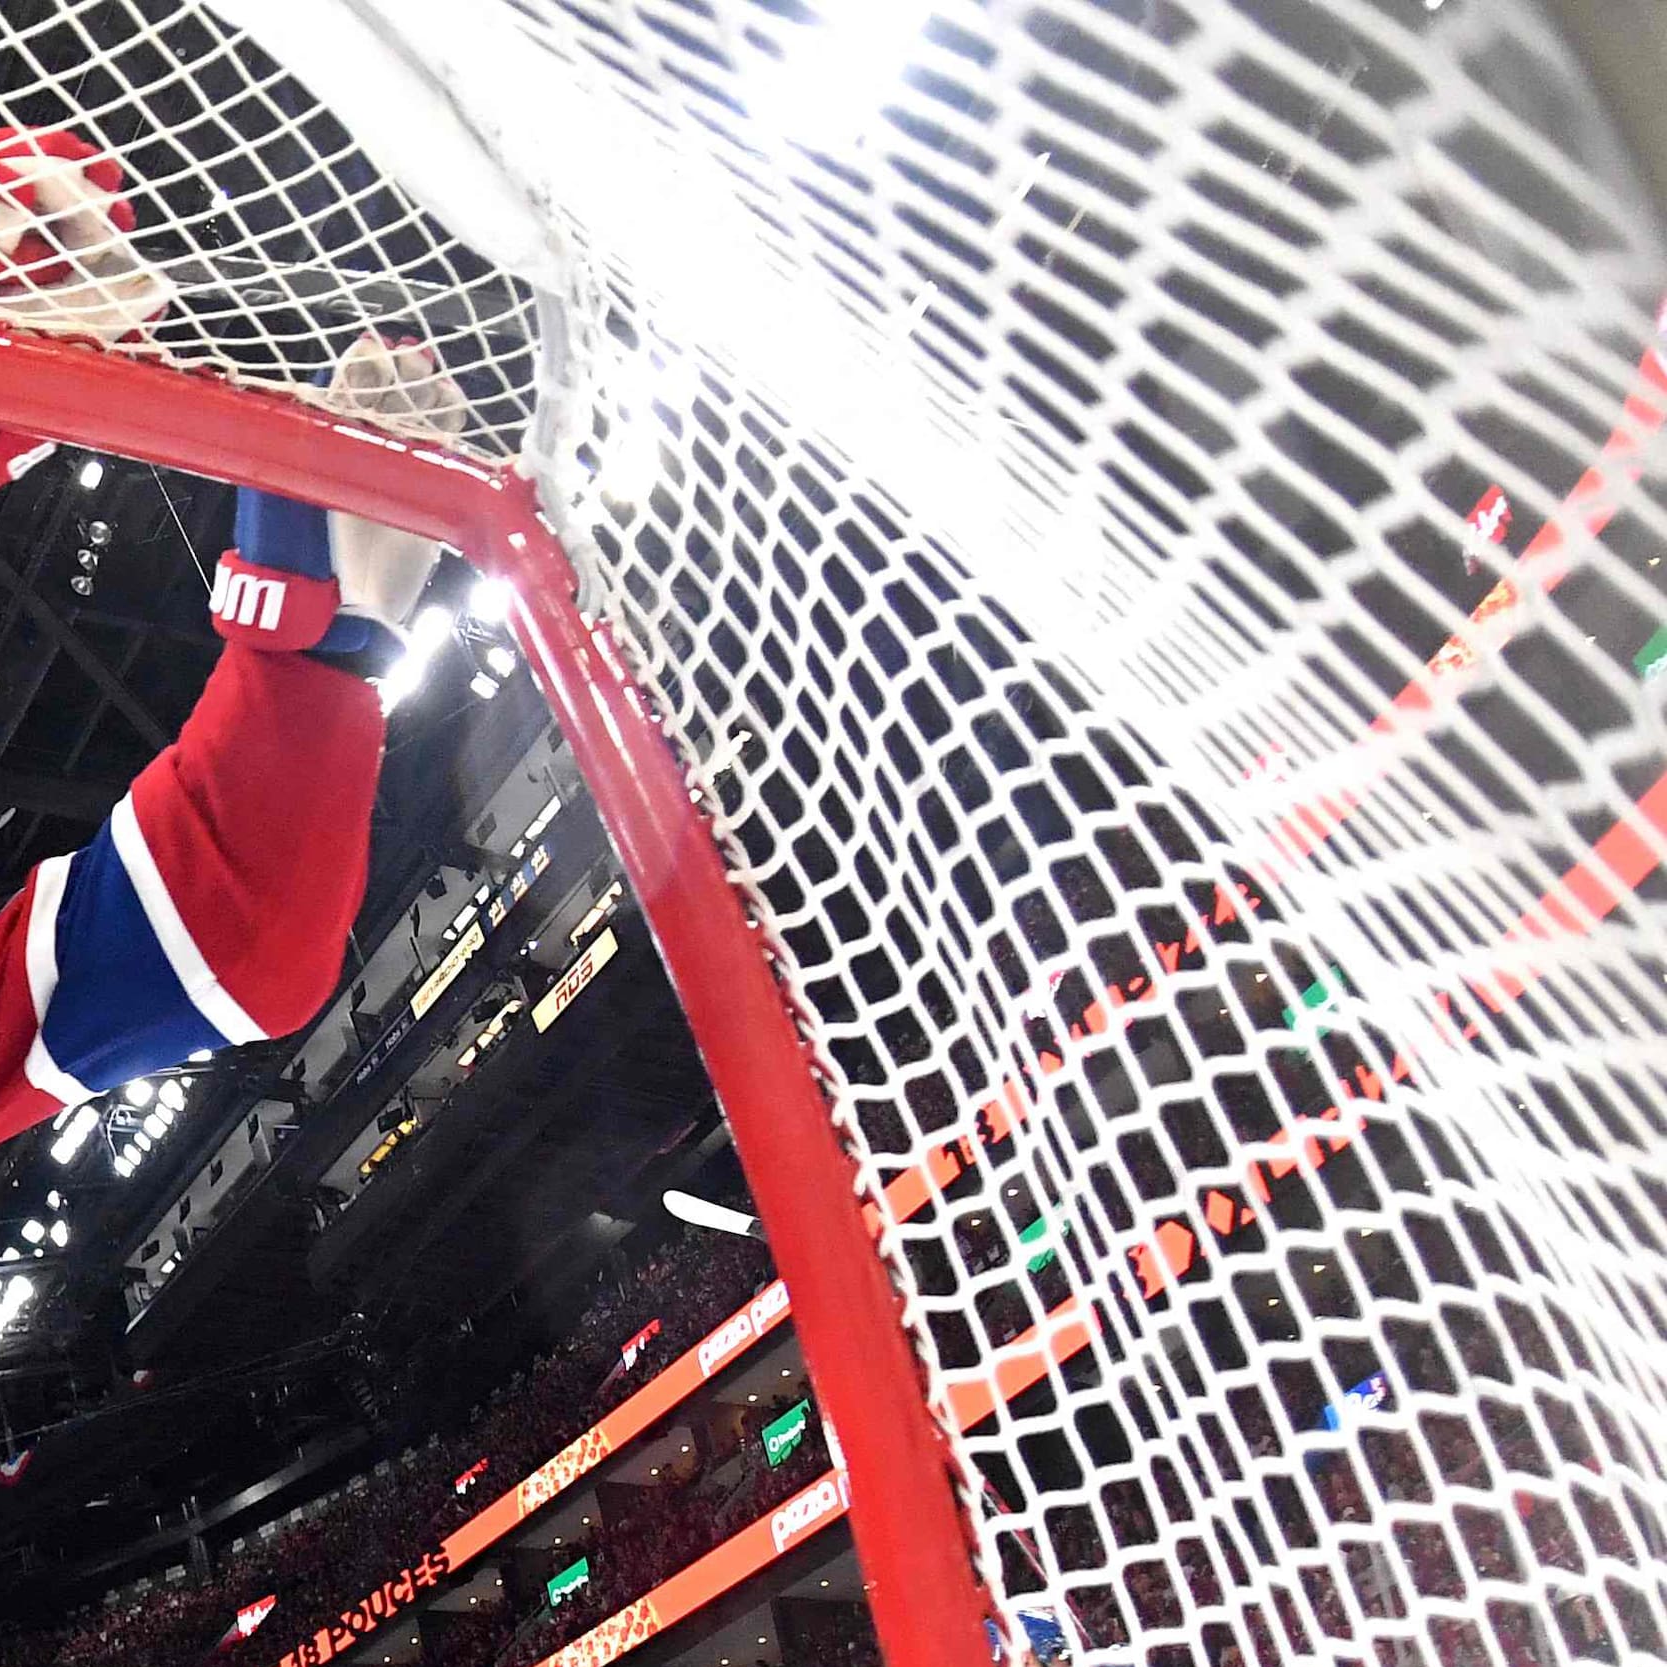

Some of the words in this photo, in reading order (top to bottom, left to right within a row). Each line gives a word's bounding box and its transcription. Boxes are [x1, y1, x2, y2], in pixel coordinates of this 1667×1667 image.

[697, 1313, 753, 1378] pizza
[770, 1480, 839, 1554] pizza
[330, 1550, 451, 1654] POUCES
